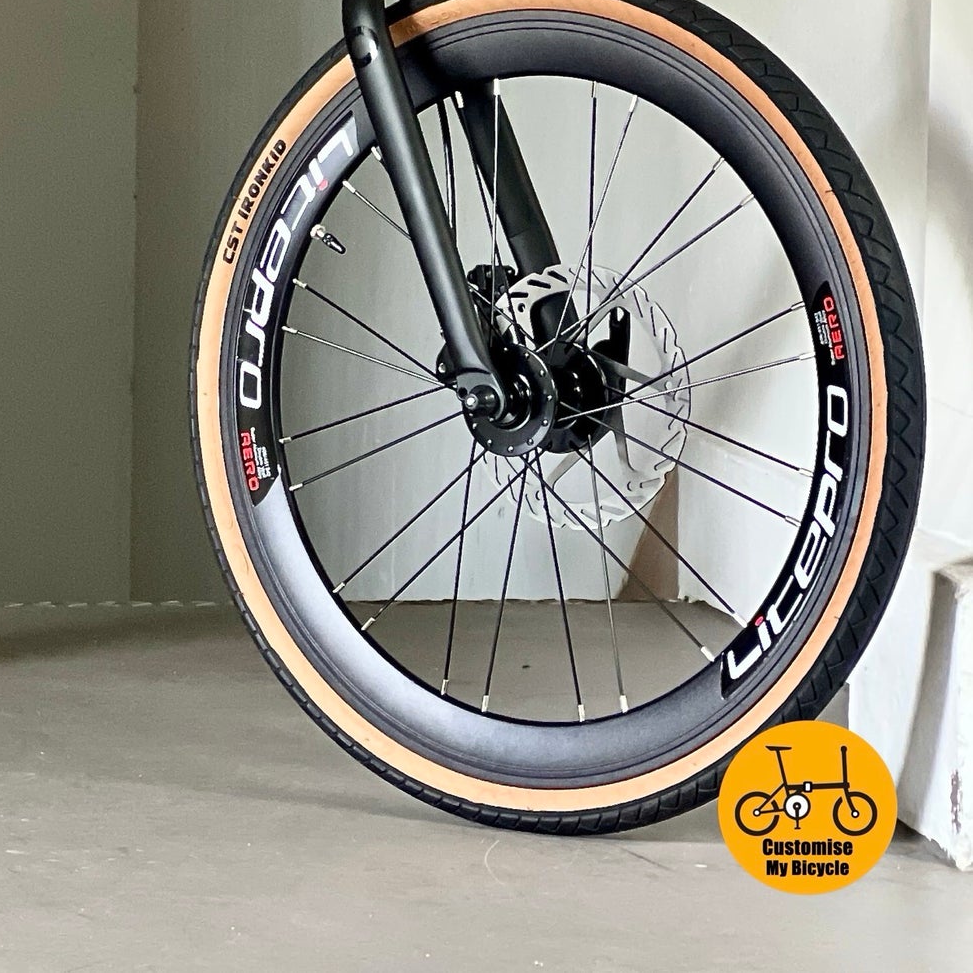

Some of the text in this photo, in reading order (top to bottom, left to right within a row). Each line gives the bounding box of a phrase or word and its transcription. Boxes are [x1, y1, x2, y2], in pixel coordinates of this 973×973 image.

[222, 139, 287, 265] CST IRONKID
[823, 296, 845, 360] AERO
[240, 432, 260, 491] AERO
